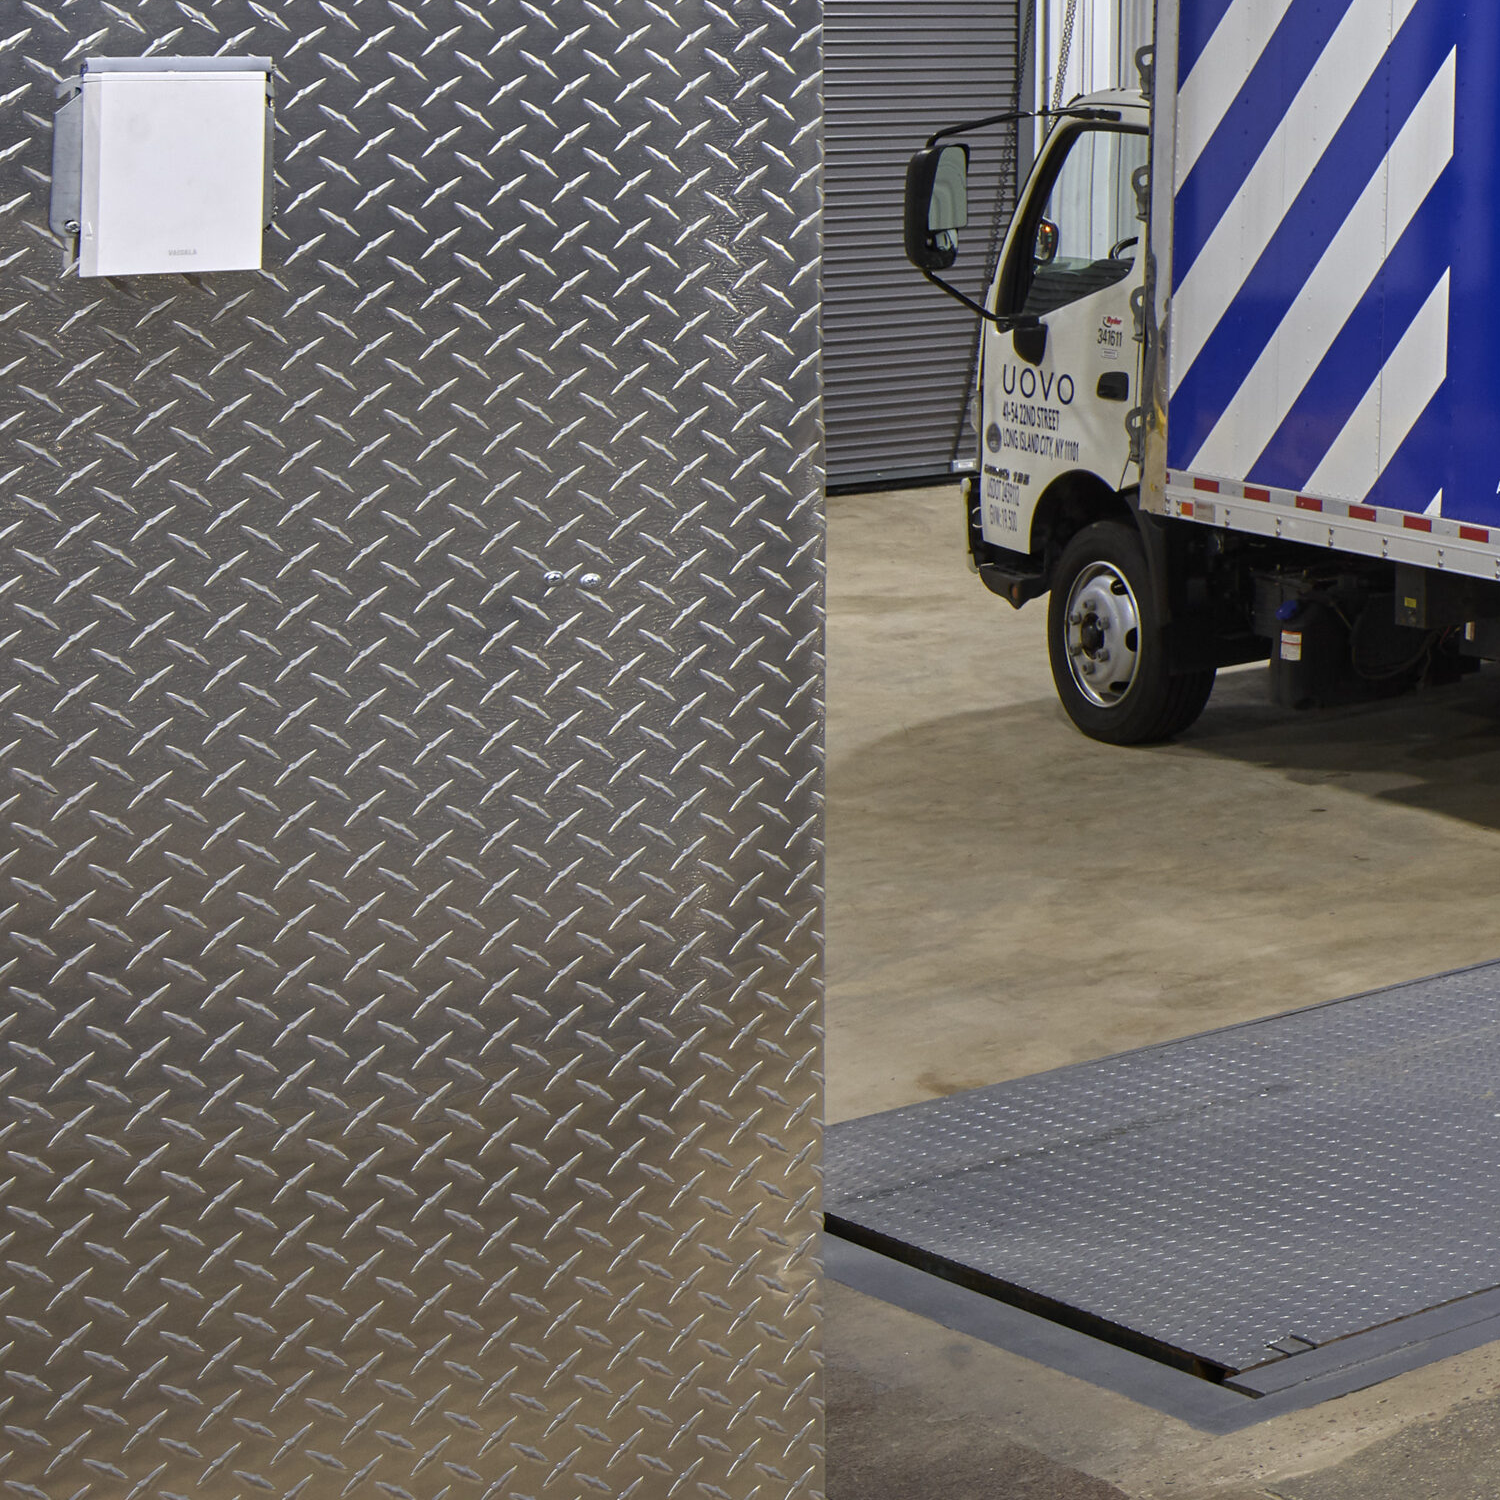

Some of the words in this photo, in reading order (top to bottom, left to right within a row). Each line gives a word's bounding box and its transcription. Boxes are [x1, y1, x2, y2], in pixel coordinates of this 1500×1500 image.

[1097, 327, 1122, 347] 341611
[1003, 364, 1075, 405] UOVO
[1020, 403, 1035, 428] 22ND
[1037, 406, 1060, 431] STREET
[1002, 427, 1018, 450] LONG
[1020, 431, 1039, 454] ISLAND
[1055, 438, 1064, 460] NY
